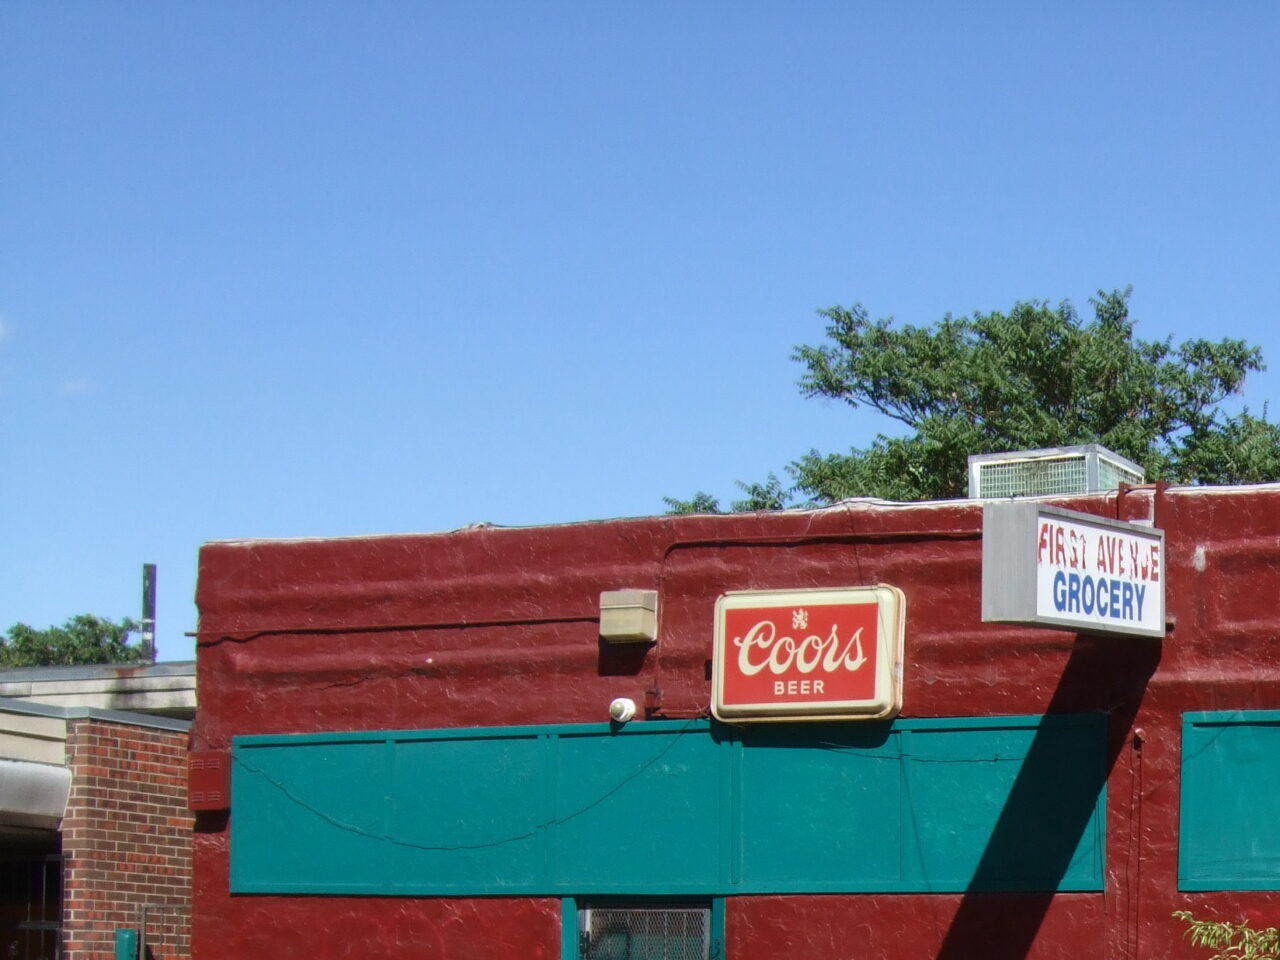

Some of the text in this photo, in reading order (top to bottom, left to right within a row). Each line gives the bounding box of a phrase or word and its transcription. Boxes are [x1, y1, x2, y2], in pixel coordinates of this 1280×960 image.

[1038, 523, 1087, 569] FIRST
[1053, 570, 1146, 622] GROCERY
[733, 620, 867, 676] Coors
[774, 680, 825, 695] BEER
